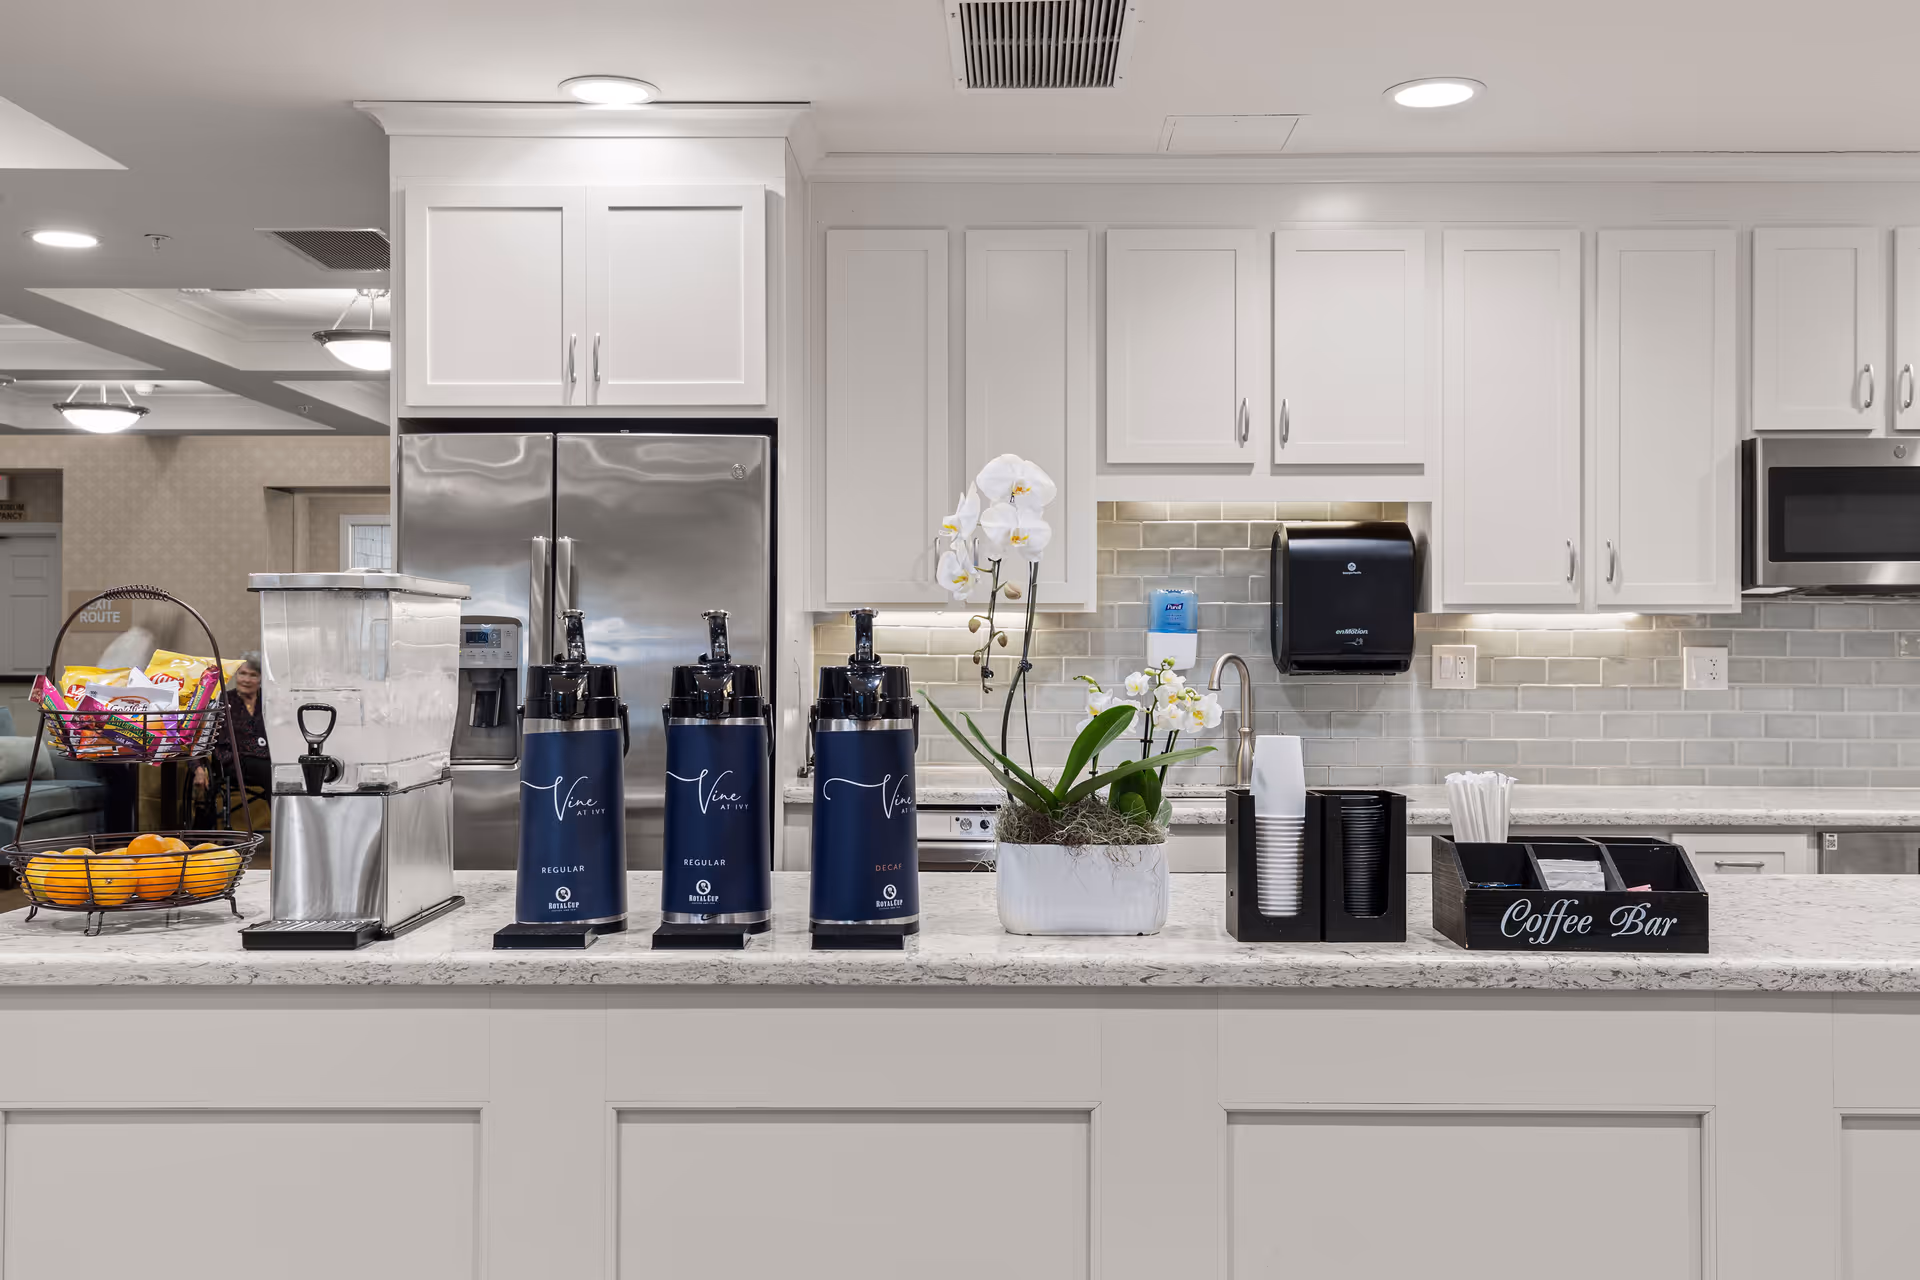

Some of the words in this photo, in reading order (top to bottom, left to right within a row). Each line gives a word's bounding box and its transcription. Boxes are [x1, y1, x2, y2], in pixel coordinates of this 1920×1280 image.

[87, 599, 112, 610] EXIT
[79, 611, 121, 623] ROUTE
[666, 769, 742, 815] Vine
[520, 776, 598, 821] Vine
[591, 808, 606, 816] IVY
[683, 859, 727, 867] REGULAR
[875, 863, 903, 872] DECAF
[541, 865, 586, 874] REGULAR
[1500, 898, 1594, 945] Coffee
[1609, 902, 1678, 938] Bar
